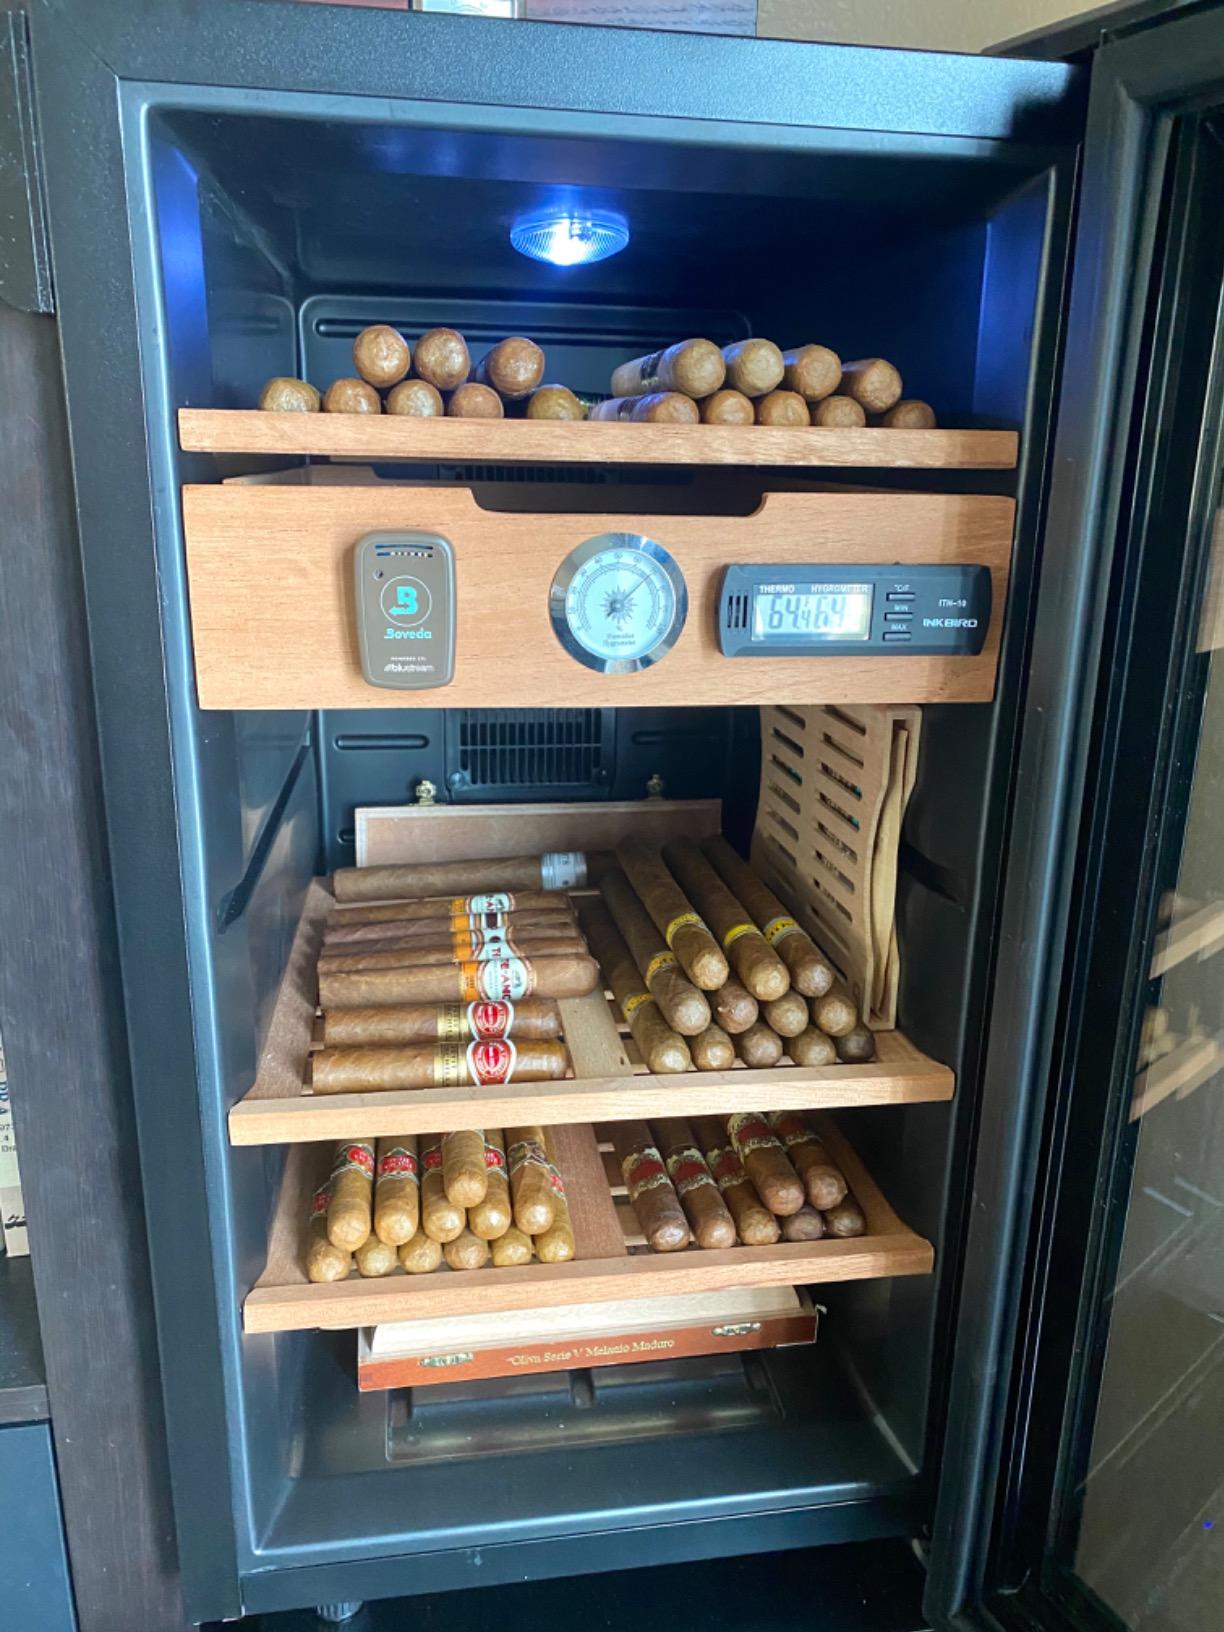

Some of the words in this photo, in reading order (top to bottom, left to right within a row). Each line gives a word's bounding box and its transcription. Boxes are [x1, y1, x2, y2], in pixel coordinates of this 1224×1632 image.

[758, 584, 796, 594] THERMO
[922, 618, 978, 628] INKBIRD
[383, 626, 433, 639] Boveda
[511, 1354, 541, 1366] Oliva
[543, 1350, 572, 1362] Serie
[572, 1349, 583, 1359] V
[632, 1338, 675, 1352] Maduro
